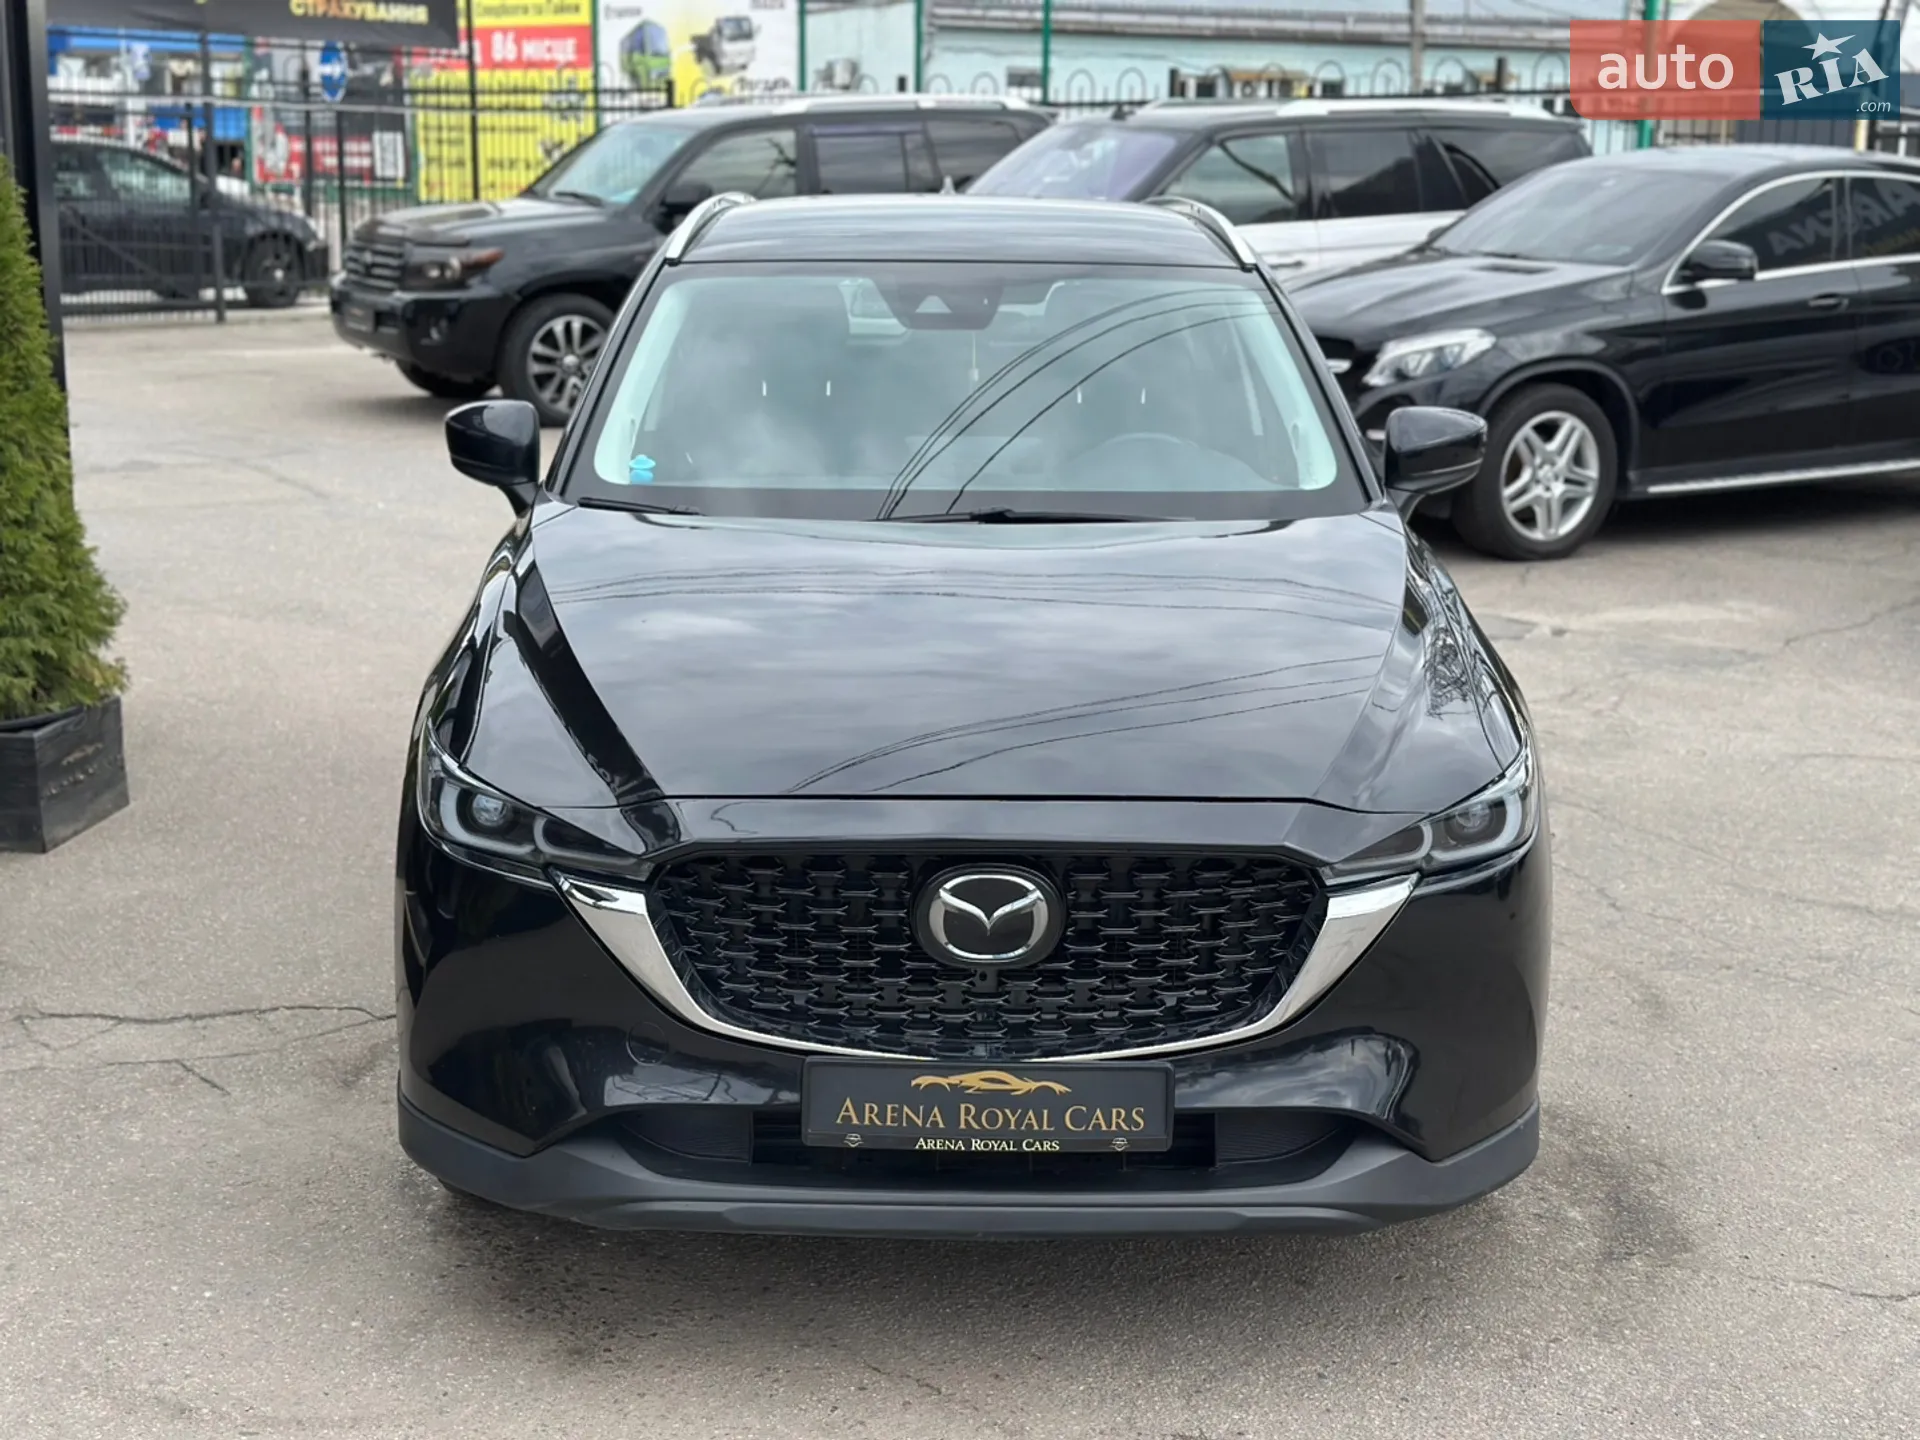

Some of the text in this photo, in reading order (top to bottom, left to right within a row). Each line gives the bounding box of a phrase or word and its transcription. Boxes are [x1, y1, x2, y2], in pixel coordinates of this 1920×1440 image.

[835, 1097, 1145, 1133] ARENA ROYAL CARS
